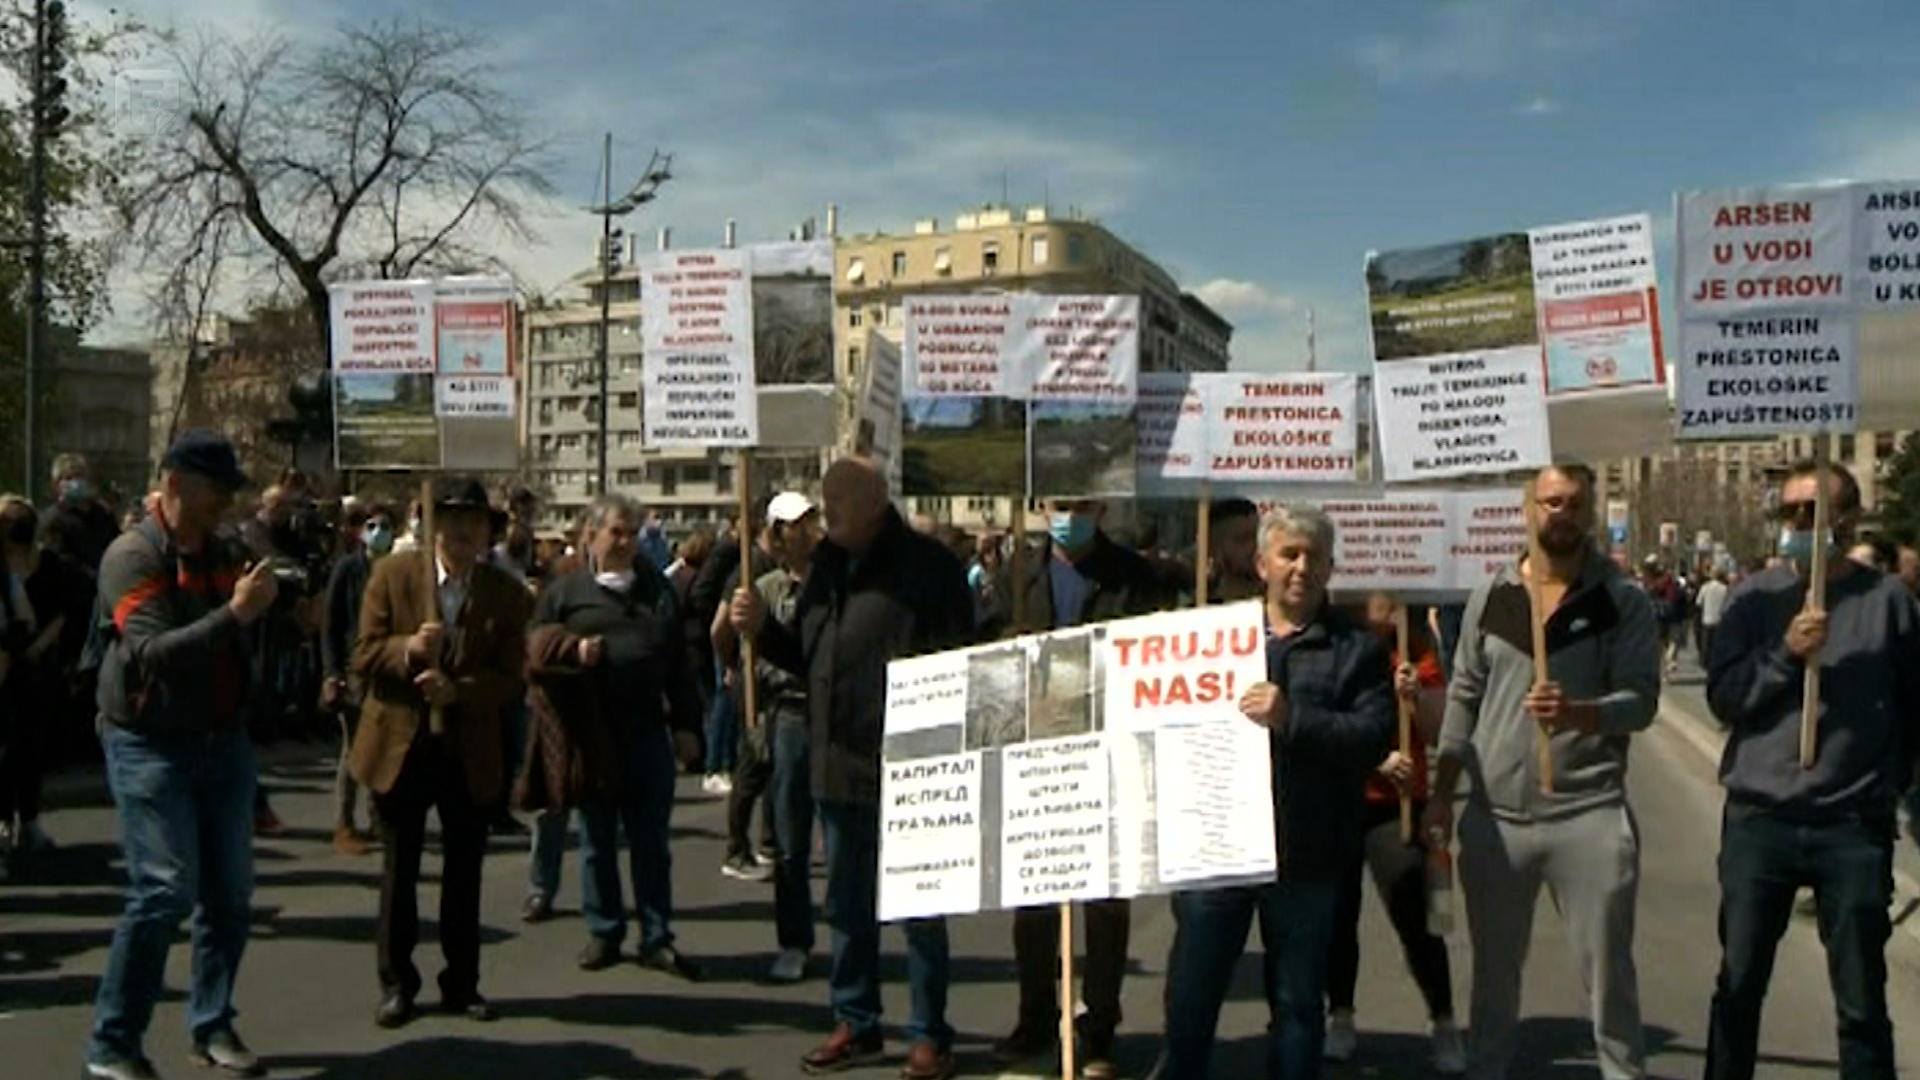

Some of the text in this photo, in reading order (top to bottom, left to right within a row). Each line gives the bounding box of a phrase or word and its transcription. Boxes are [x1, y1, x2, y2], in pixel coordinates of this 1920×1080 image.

[1714, 202, 1812, 227] ARSEN
[1714, 238, 1812, 263] U VODI
[1693, 274, 1843, 301] JE OTROVI
[1876, 284, 1891, 302] U
[1718, 318, 1819, 338] TEMERIN
[1696, 346, 1840, 367] PRESTONICA
[1243, 383, 1324, 396] TEMERIN
[1391, 380, 1437, 397] TRUJE
[1708, 375, 1829, 396] EKOLOŠKE
[1224, 406, 1342, 419] PRESTONICA
[1420, 396, 1505, 413] PO NALOGU
[1682, 403, 1853, 426] ZAPUŠTENOSTI
[1234, 429, 1332, 446] EKOLOŠKE
[1212, 454, 1353, 470] ZAPUŠTENOSTI
[1112, 626, 1257, 666] TRUJU
[1133, 669, 1235, 708] NAS!
[891, 759, 974, 782] КАПИТАЛ
[895, 785, 968, 806] ИСПРЕД
[888, 812, 974, 832] ГРАЂАНА
